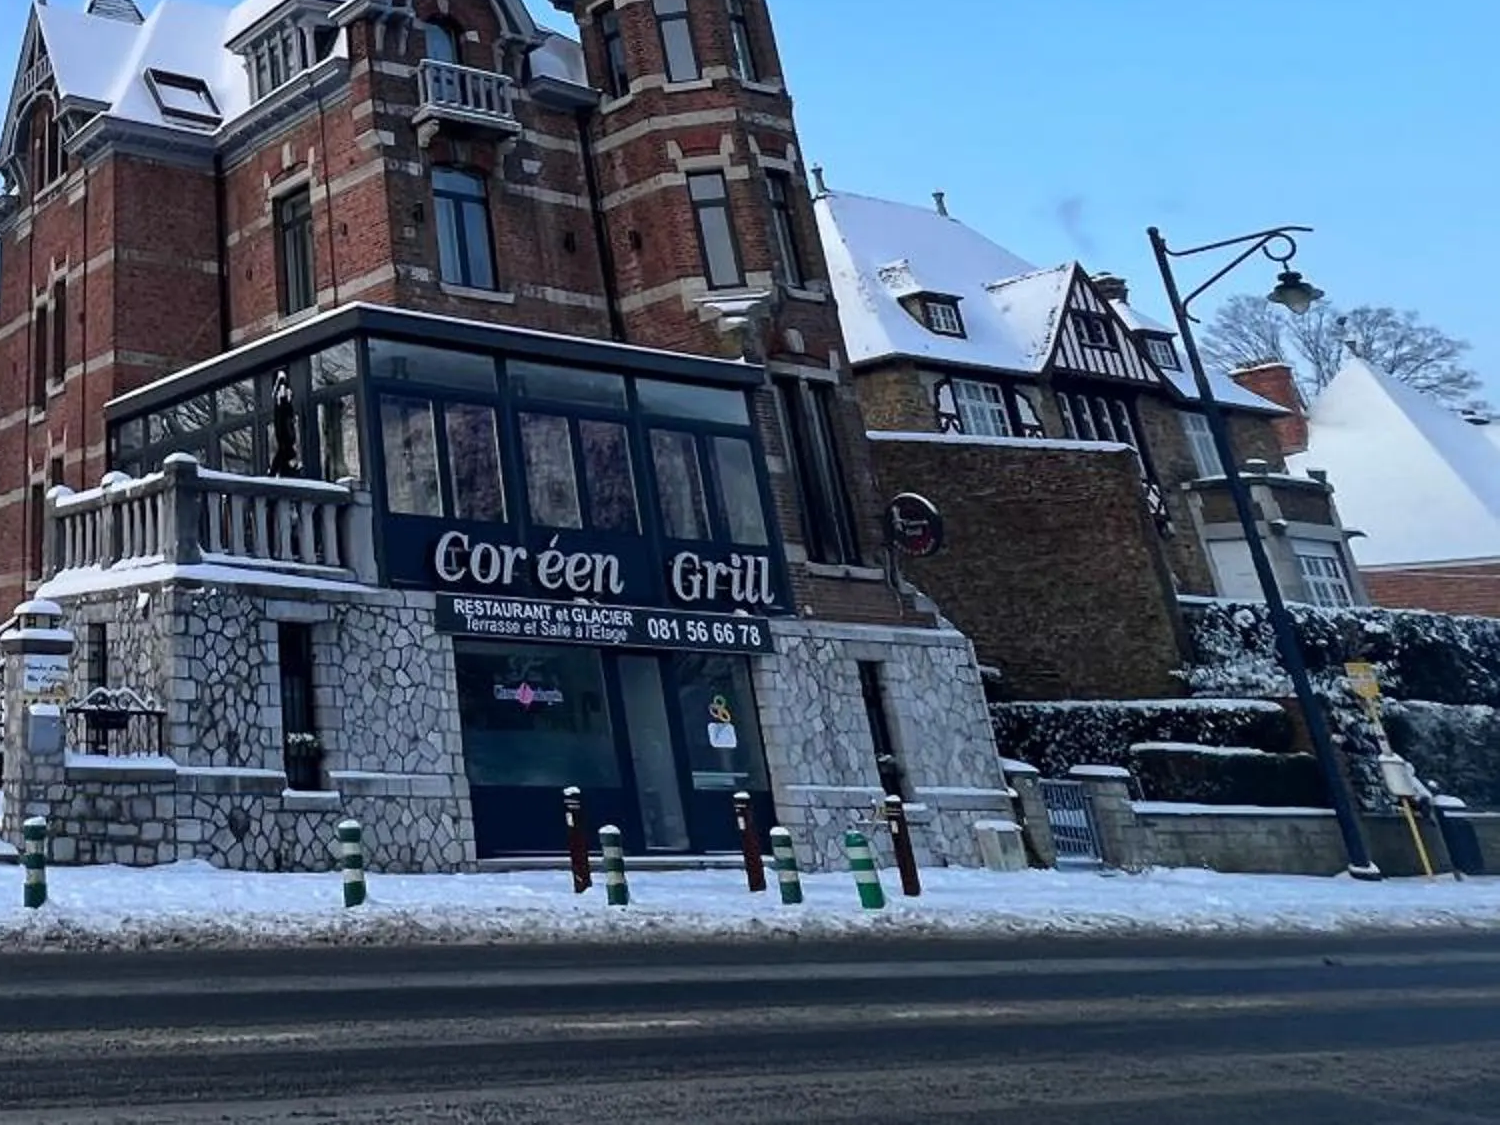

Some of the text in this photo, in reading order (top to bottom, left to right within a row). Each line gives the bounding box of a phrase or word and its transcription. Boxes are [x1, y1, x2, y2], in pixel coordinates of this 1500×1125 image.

[672, 551, 775, 604] Grill
[453, 598, 634, 627] RESTAURANT et GLACIER
[464, 614, 521, 634] Terrasse
[524, 621, 537, 636] et
[540, 620, 571, 637] Salle
[647, 618, 761, 646] 081 56 66 78
